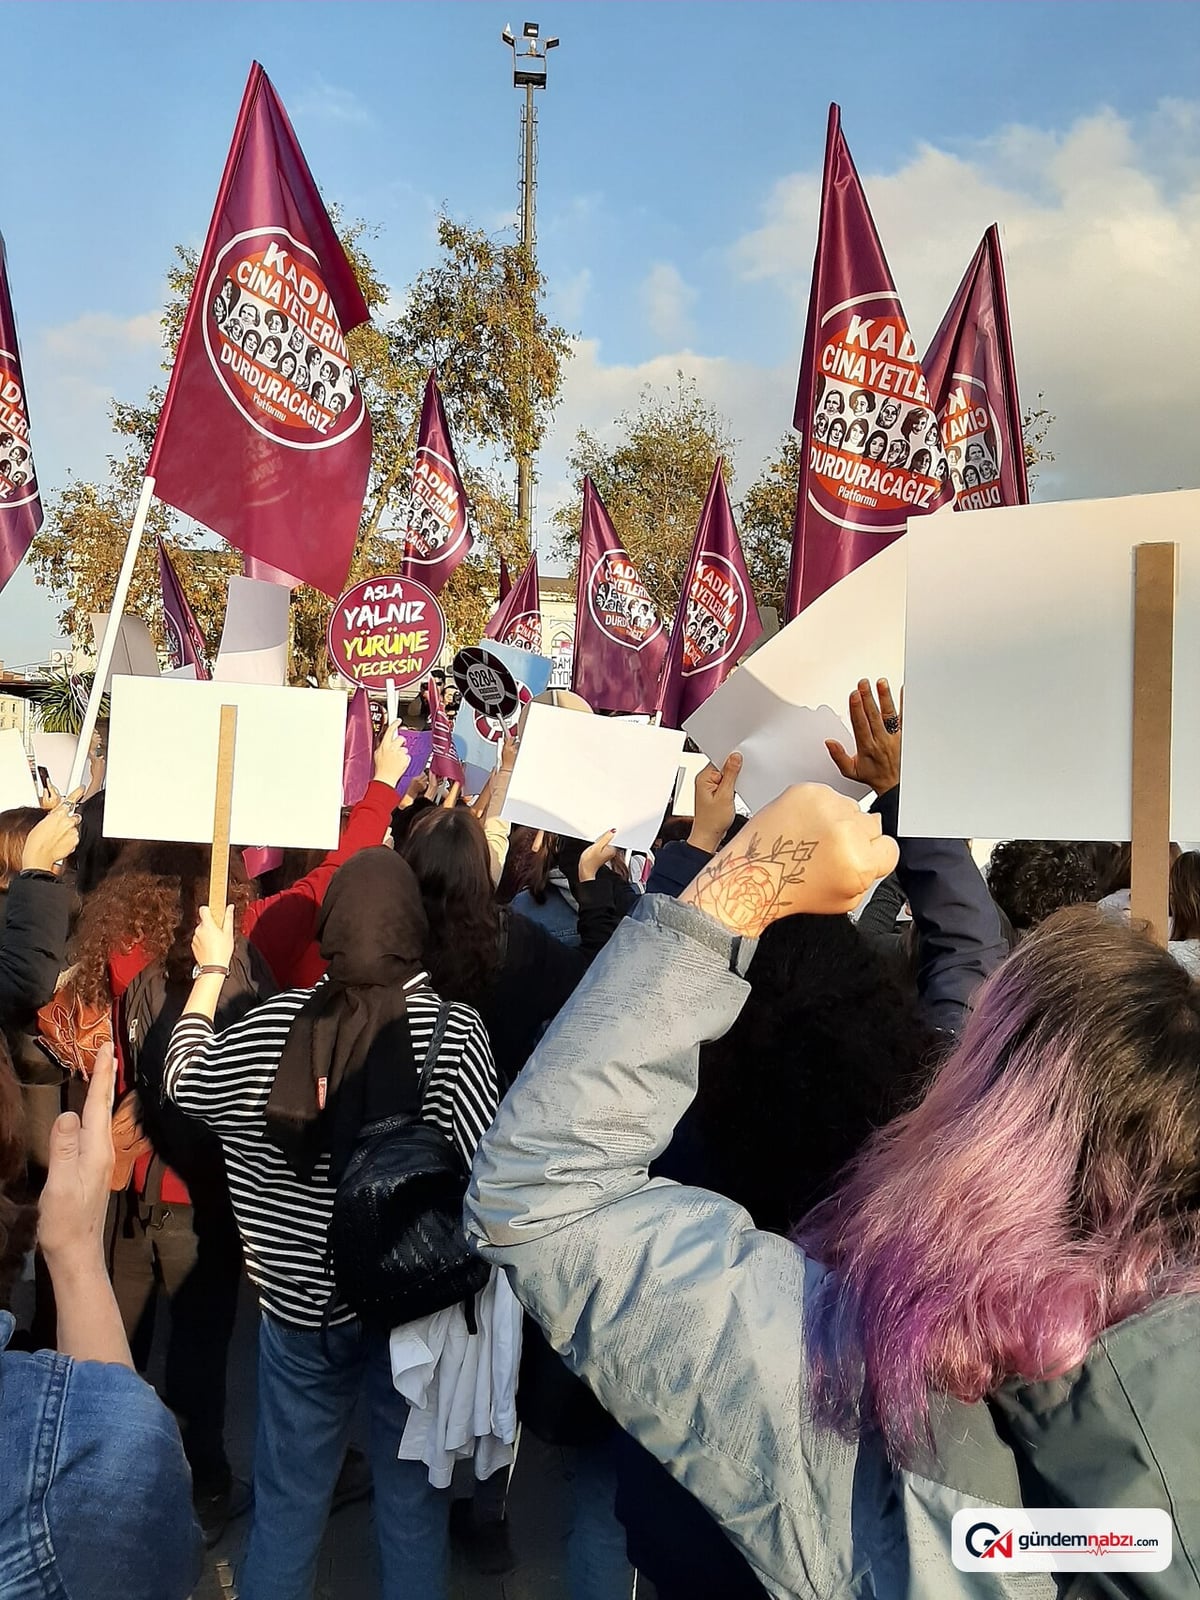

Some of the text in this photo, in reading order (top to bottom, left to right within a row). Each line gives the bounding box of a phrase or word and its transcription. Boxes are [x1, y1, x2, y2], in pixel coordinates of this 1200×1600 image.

[220, 343, 330, 434] DURDURACAĞIZ
[252, 393, 287, 421] Platformu
[837, 487, 878, 507] Platformu
[363, 583, 403, 601] ASLA
[695, 559, 738, 607] KADIN
[344, 601, 426, 631] YALNIZ
[344, 626, 430, 660] YÜRÜME
[353, 655, 422, 679] YECEKSİN
[468, 669, 497, 687] 6284
